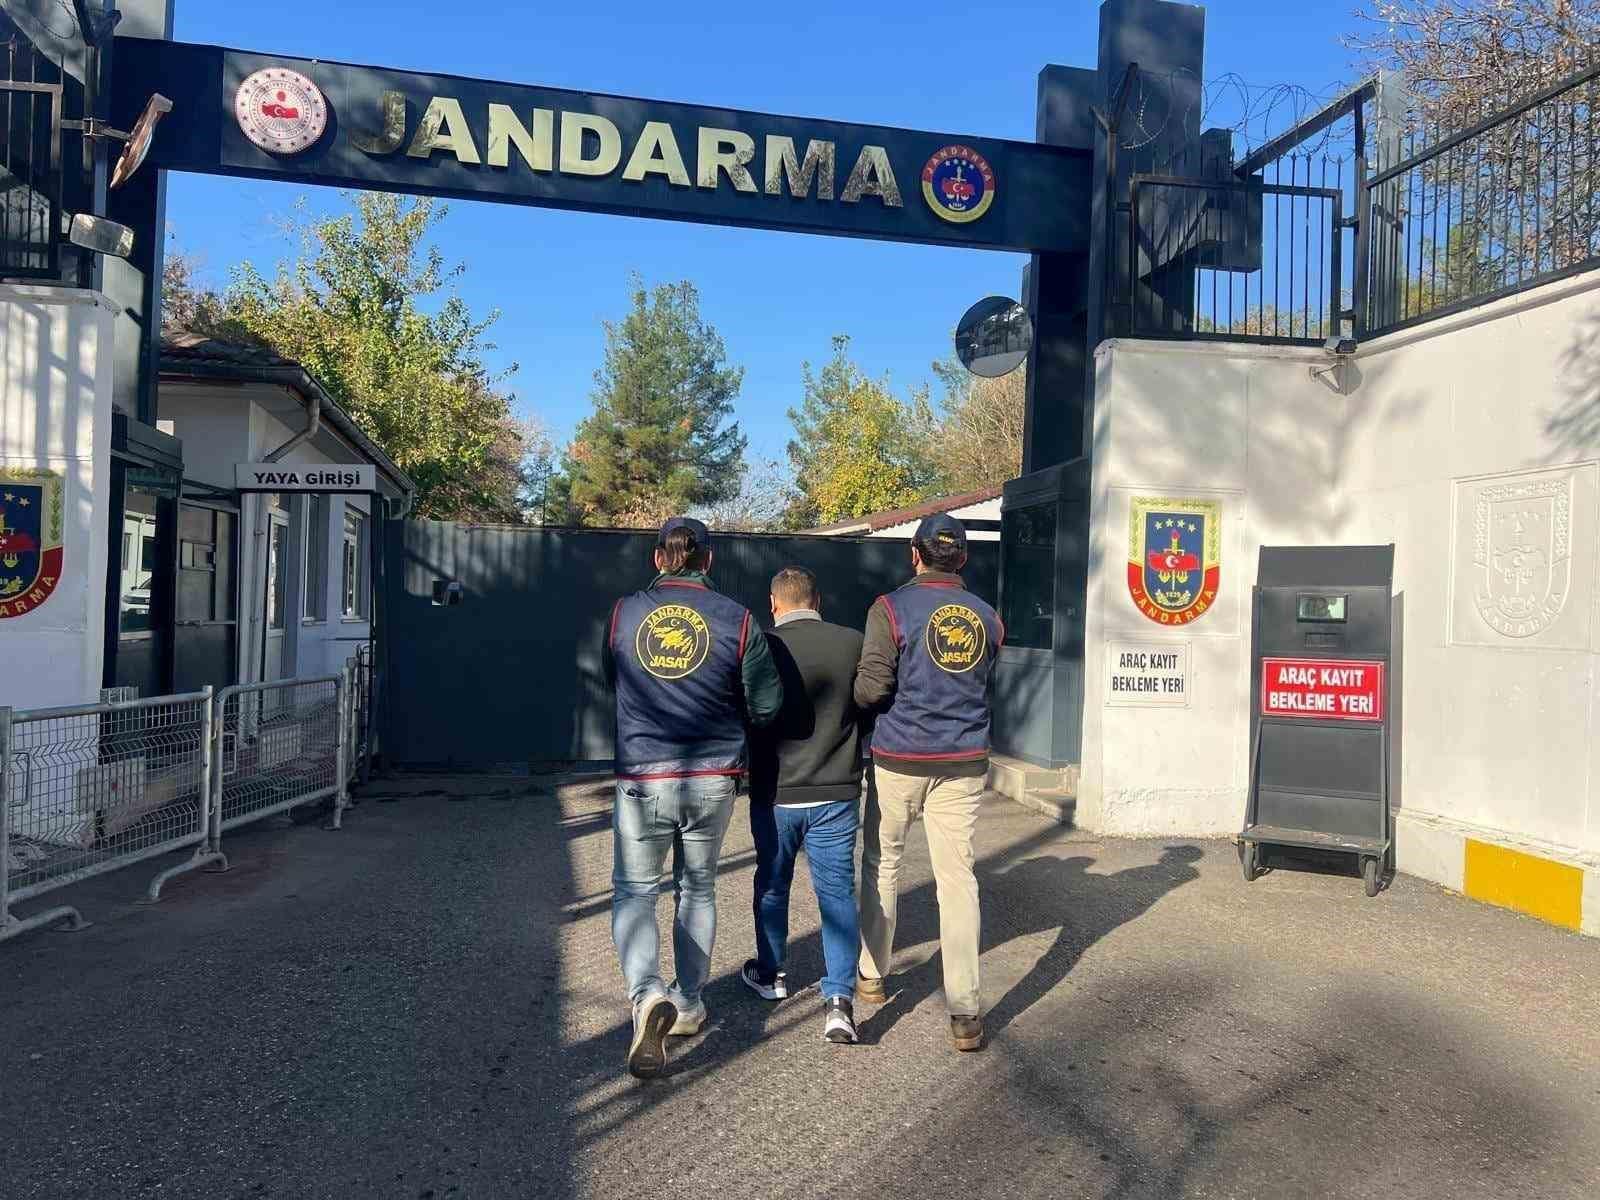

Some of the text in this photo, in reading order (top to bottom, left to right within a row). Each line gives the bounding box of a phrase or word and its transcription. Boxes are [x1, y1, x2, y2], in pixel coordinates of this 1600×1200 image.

[351, 90, 903, 208] JANDARMA
[254, 470, 360, 487] YAYA GİRİŞİ
[1133, 588, 1214, 624] JANDARMA
[647, 607, 705, 632] JANDARMA
[932, 607, 979, 628] JANDARMA
[650, 656, 689, 669] JASAT
[940, 652, 971, 663] JASAT
[1120, 653, 1178, 673] ARAÇ KAYIT
[1112, 672, 1184, 693] BEKLEME YERİ
[1278, 667, 1364, 689] ARAÇ KAYIT
[1269, 692, 1373, 713] BEKLEME YERİ
